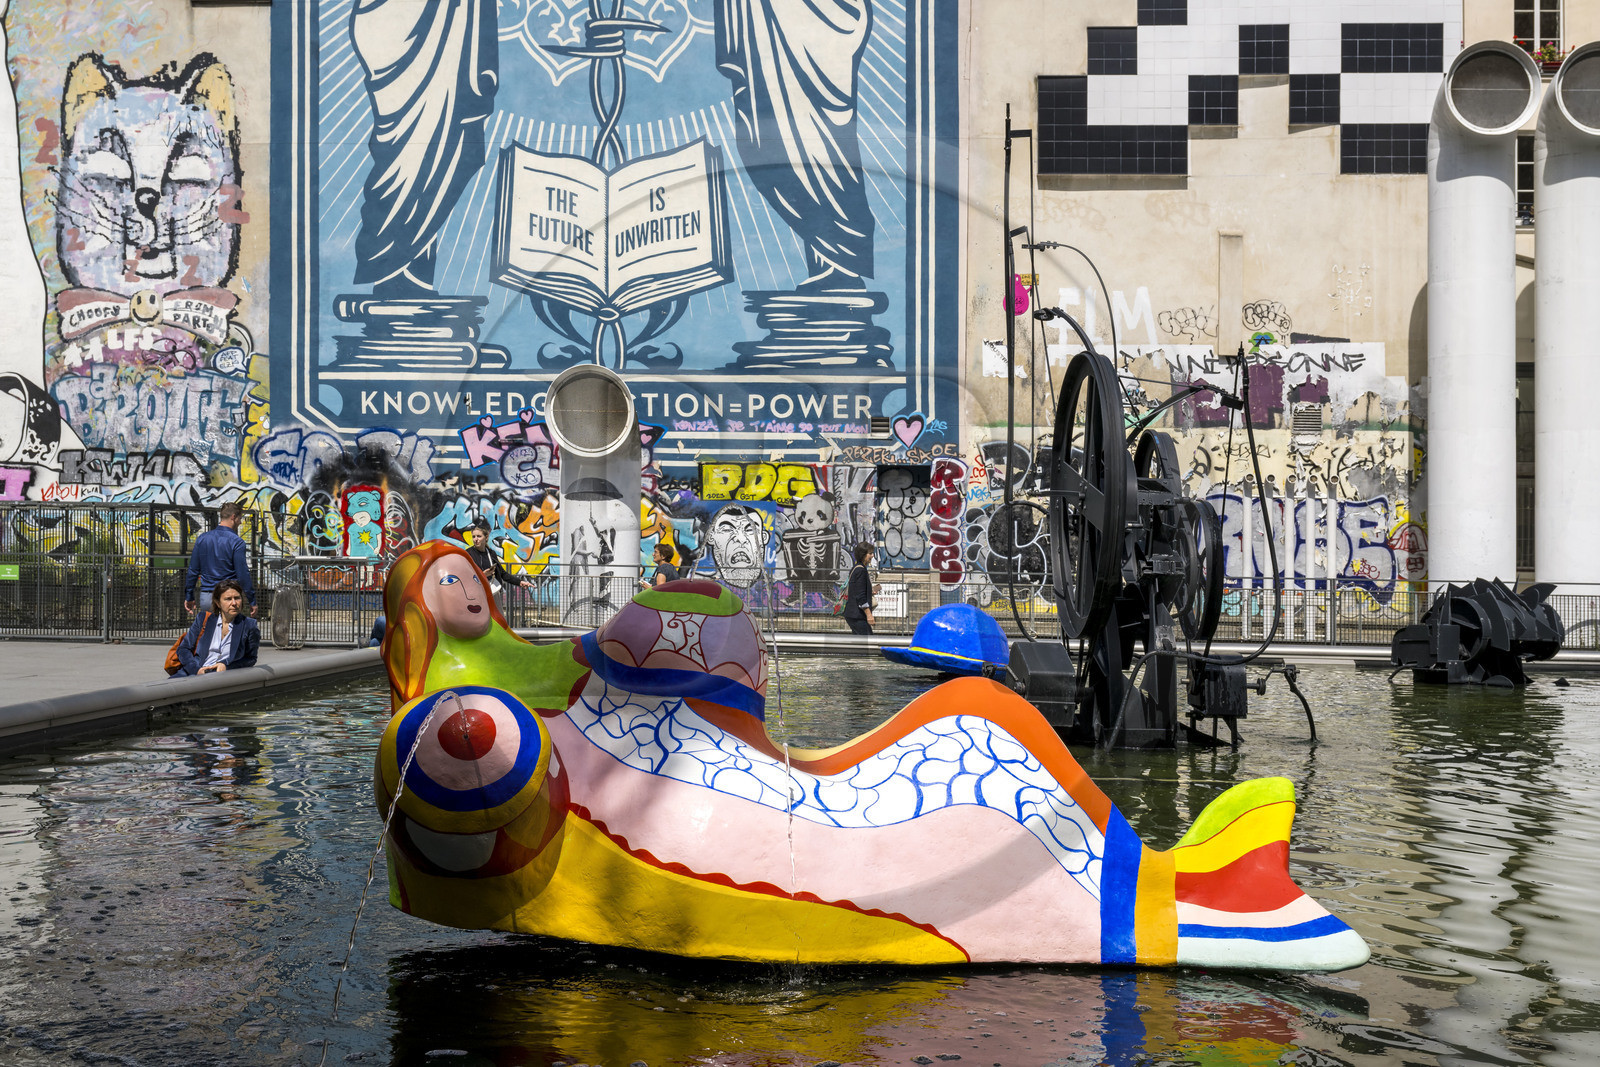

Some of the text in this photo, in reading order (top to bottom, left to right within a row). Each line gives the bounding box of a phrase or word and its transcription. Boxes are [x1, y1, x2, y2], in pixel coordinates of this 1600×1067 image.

[545, 186, 579, 217] THE
[649, 186, 666, 212] IS
[529, 212, 595, 257] FUTURE
[615, 210, 701, 258] UNWRITTEN
